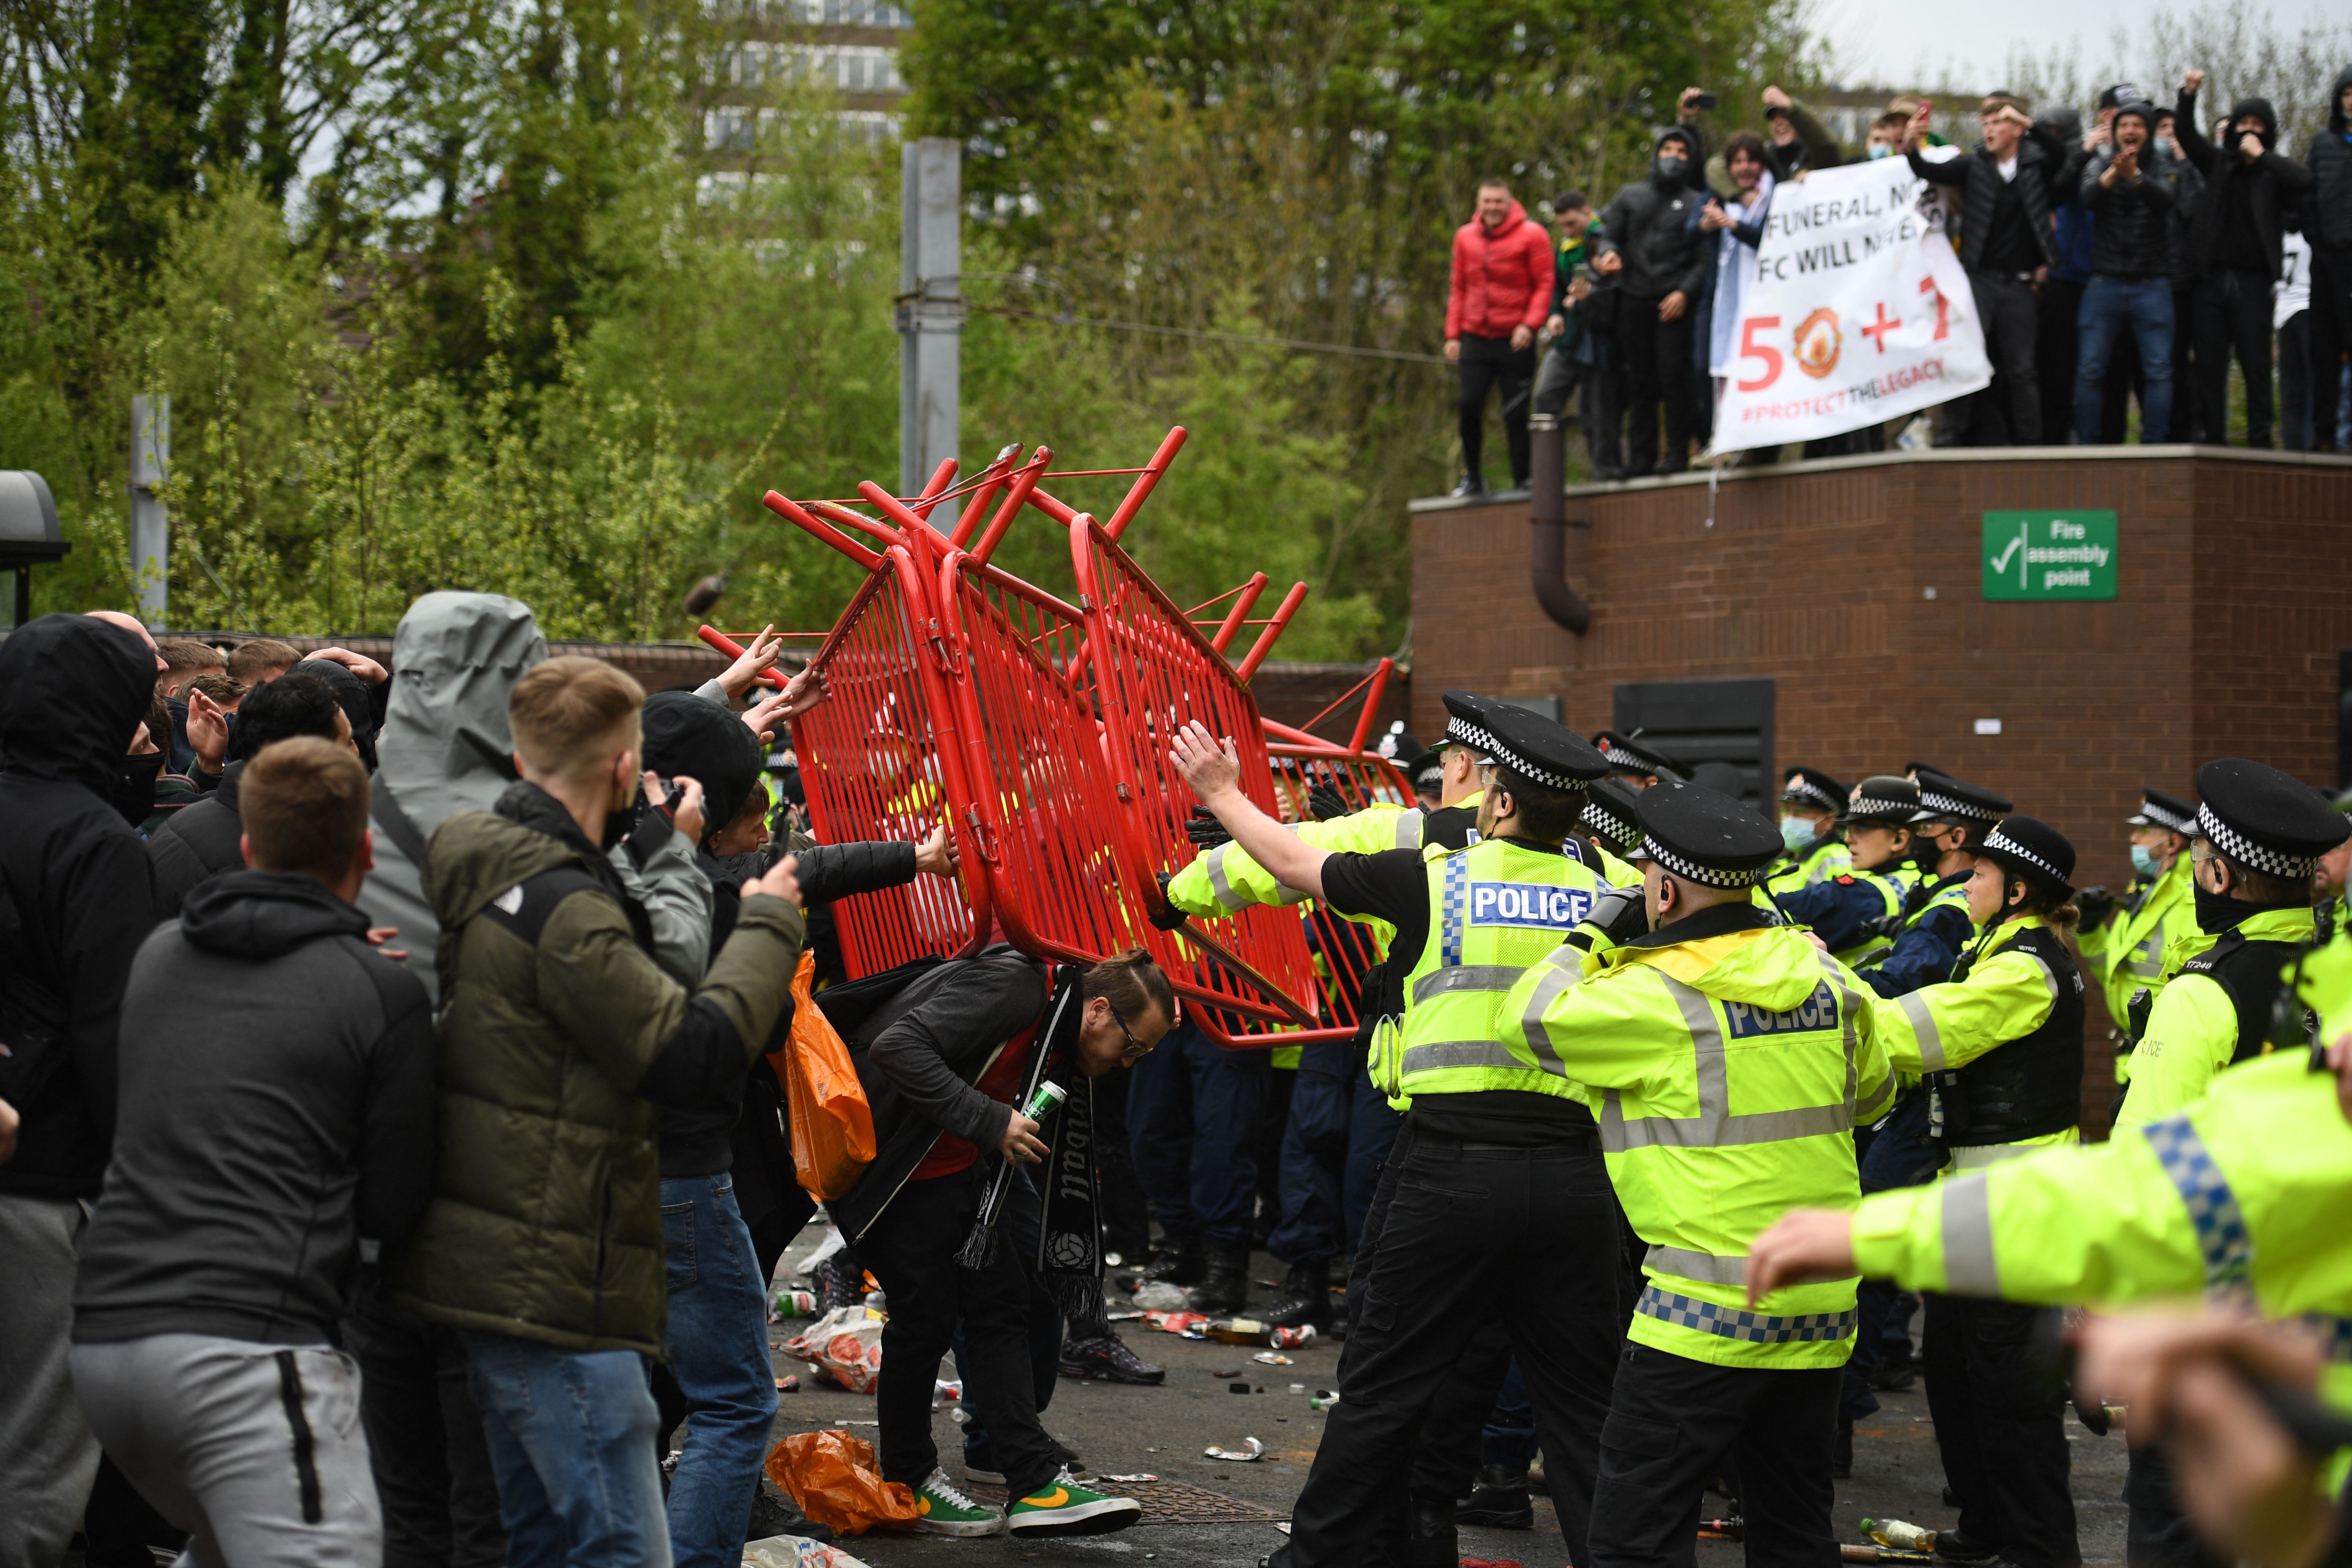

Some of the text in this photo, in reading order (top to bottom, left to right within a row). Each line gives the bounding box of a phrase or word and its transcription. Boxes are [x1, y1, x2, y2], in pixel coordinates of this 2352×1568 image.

[1758, 258, 1788, 282] FC
[1796, 240, 1856, 273] WILL
[2051, 520, 2085, 539] Fire
[2027, 544, 2109, 567] assembly
[2044, 568, 2090, 590] point
[1475, 888, 1587, 923] POLICE
[2186, 961, 2212, 969] 17240
